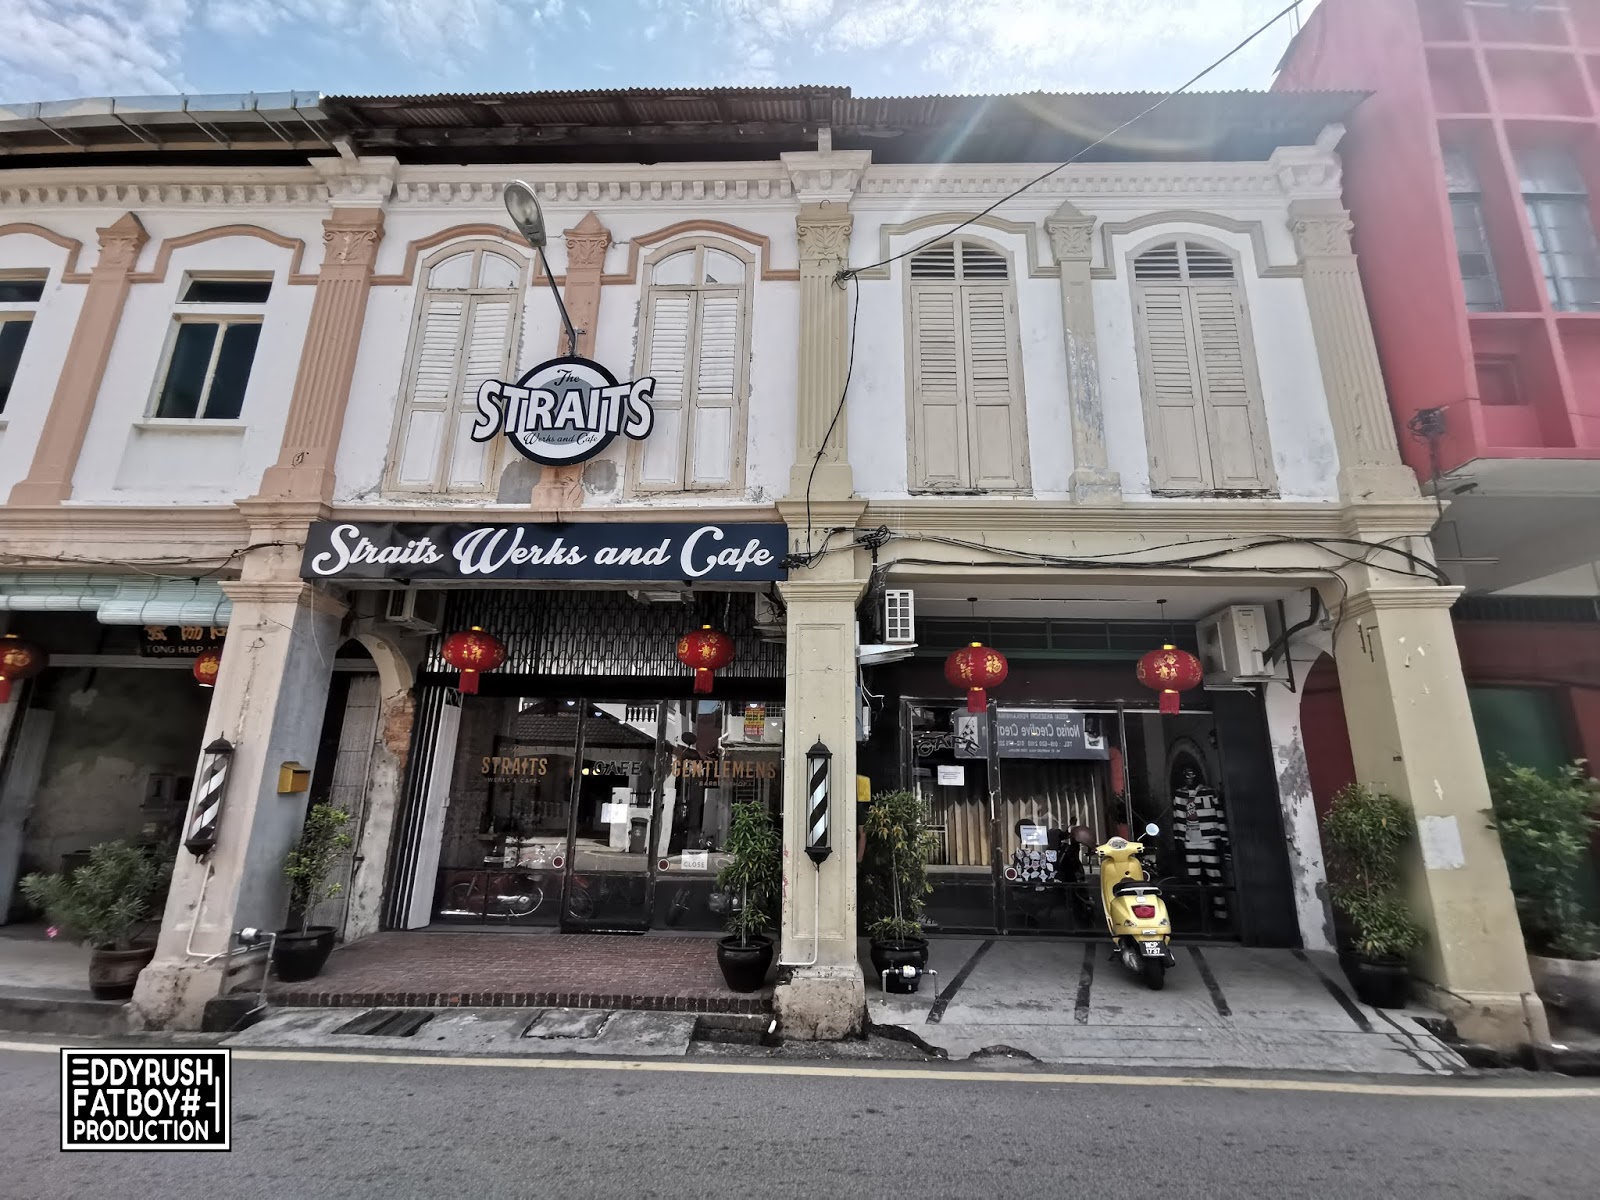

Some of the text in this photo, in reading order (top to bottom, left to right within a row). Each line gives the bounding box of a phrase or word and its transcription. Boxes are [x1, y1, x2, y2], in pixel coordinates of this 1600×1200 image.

[554, 369, 580, 387] The
[471, 377, 656, 443] STRAITS
[523, 432, 598, 446] Werks and Cafe
[311, 524, 775, 578] Straits Werks and Cafe
[146, 645, 175, 653] TONG
[178, 645, 204, 654] HIAP
[916, 734, 982, 757] CAFE
[481, 756, 548, 776] STRAITS
[593, 760, 642, 776] CAFE
[671, 759, 776, 779] GENTLEMENS
